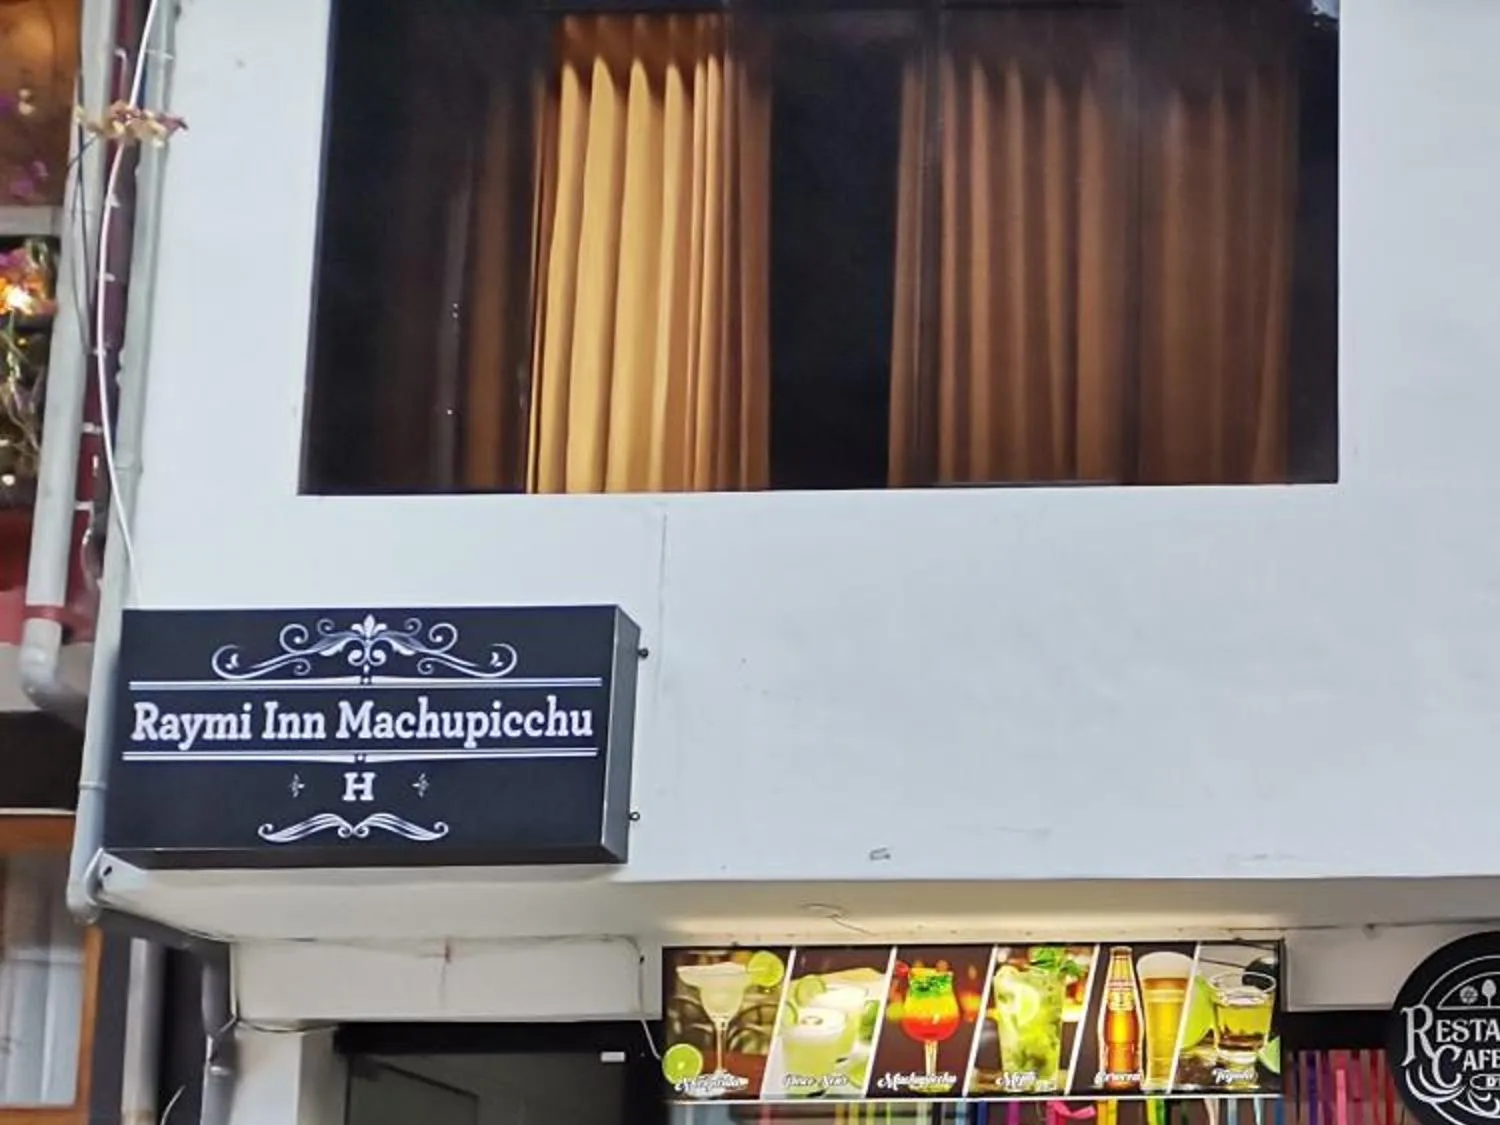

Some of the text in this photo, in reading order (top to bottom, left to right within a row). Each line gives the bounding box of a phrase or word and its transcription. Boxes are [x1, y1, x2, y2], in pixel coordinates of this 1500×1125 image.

[131, 695, 594, 751] Raymi Inn Machupicchu
[342, 772, 376, 801] H
